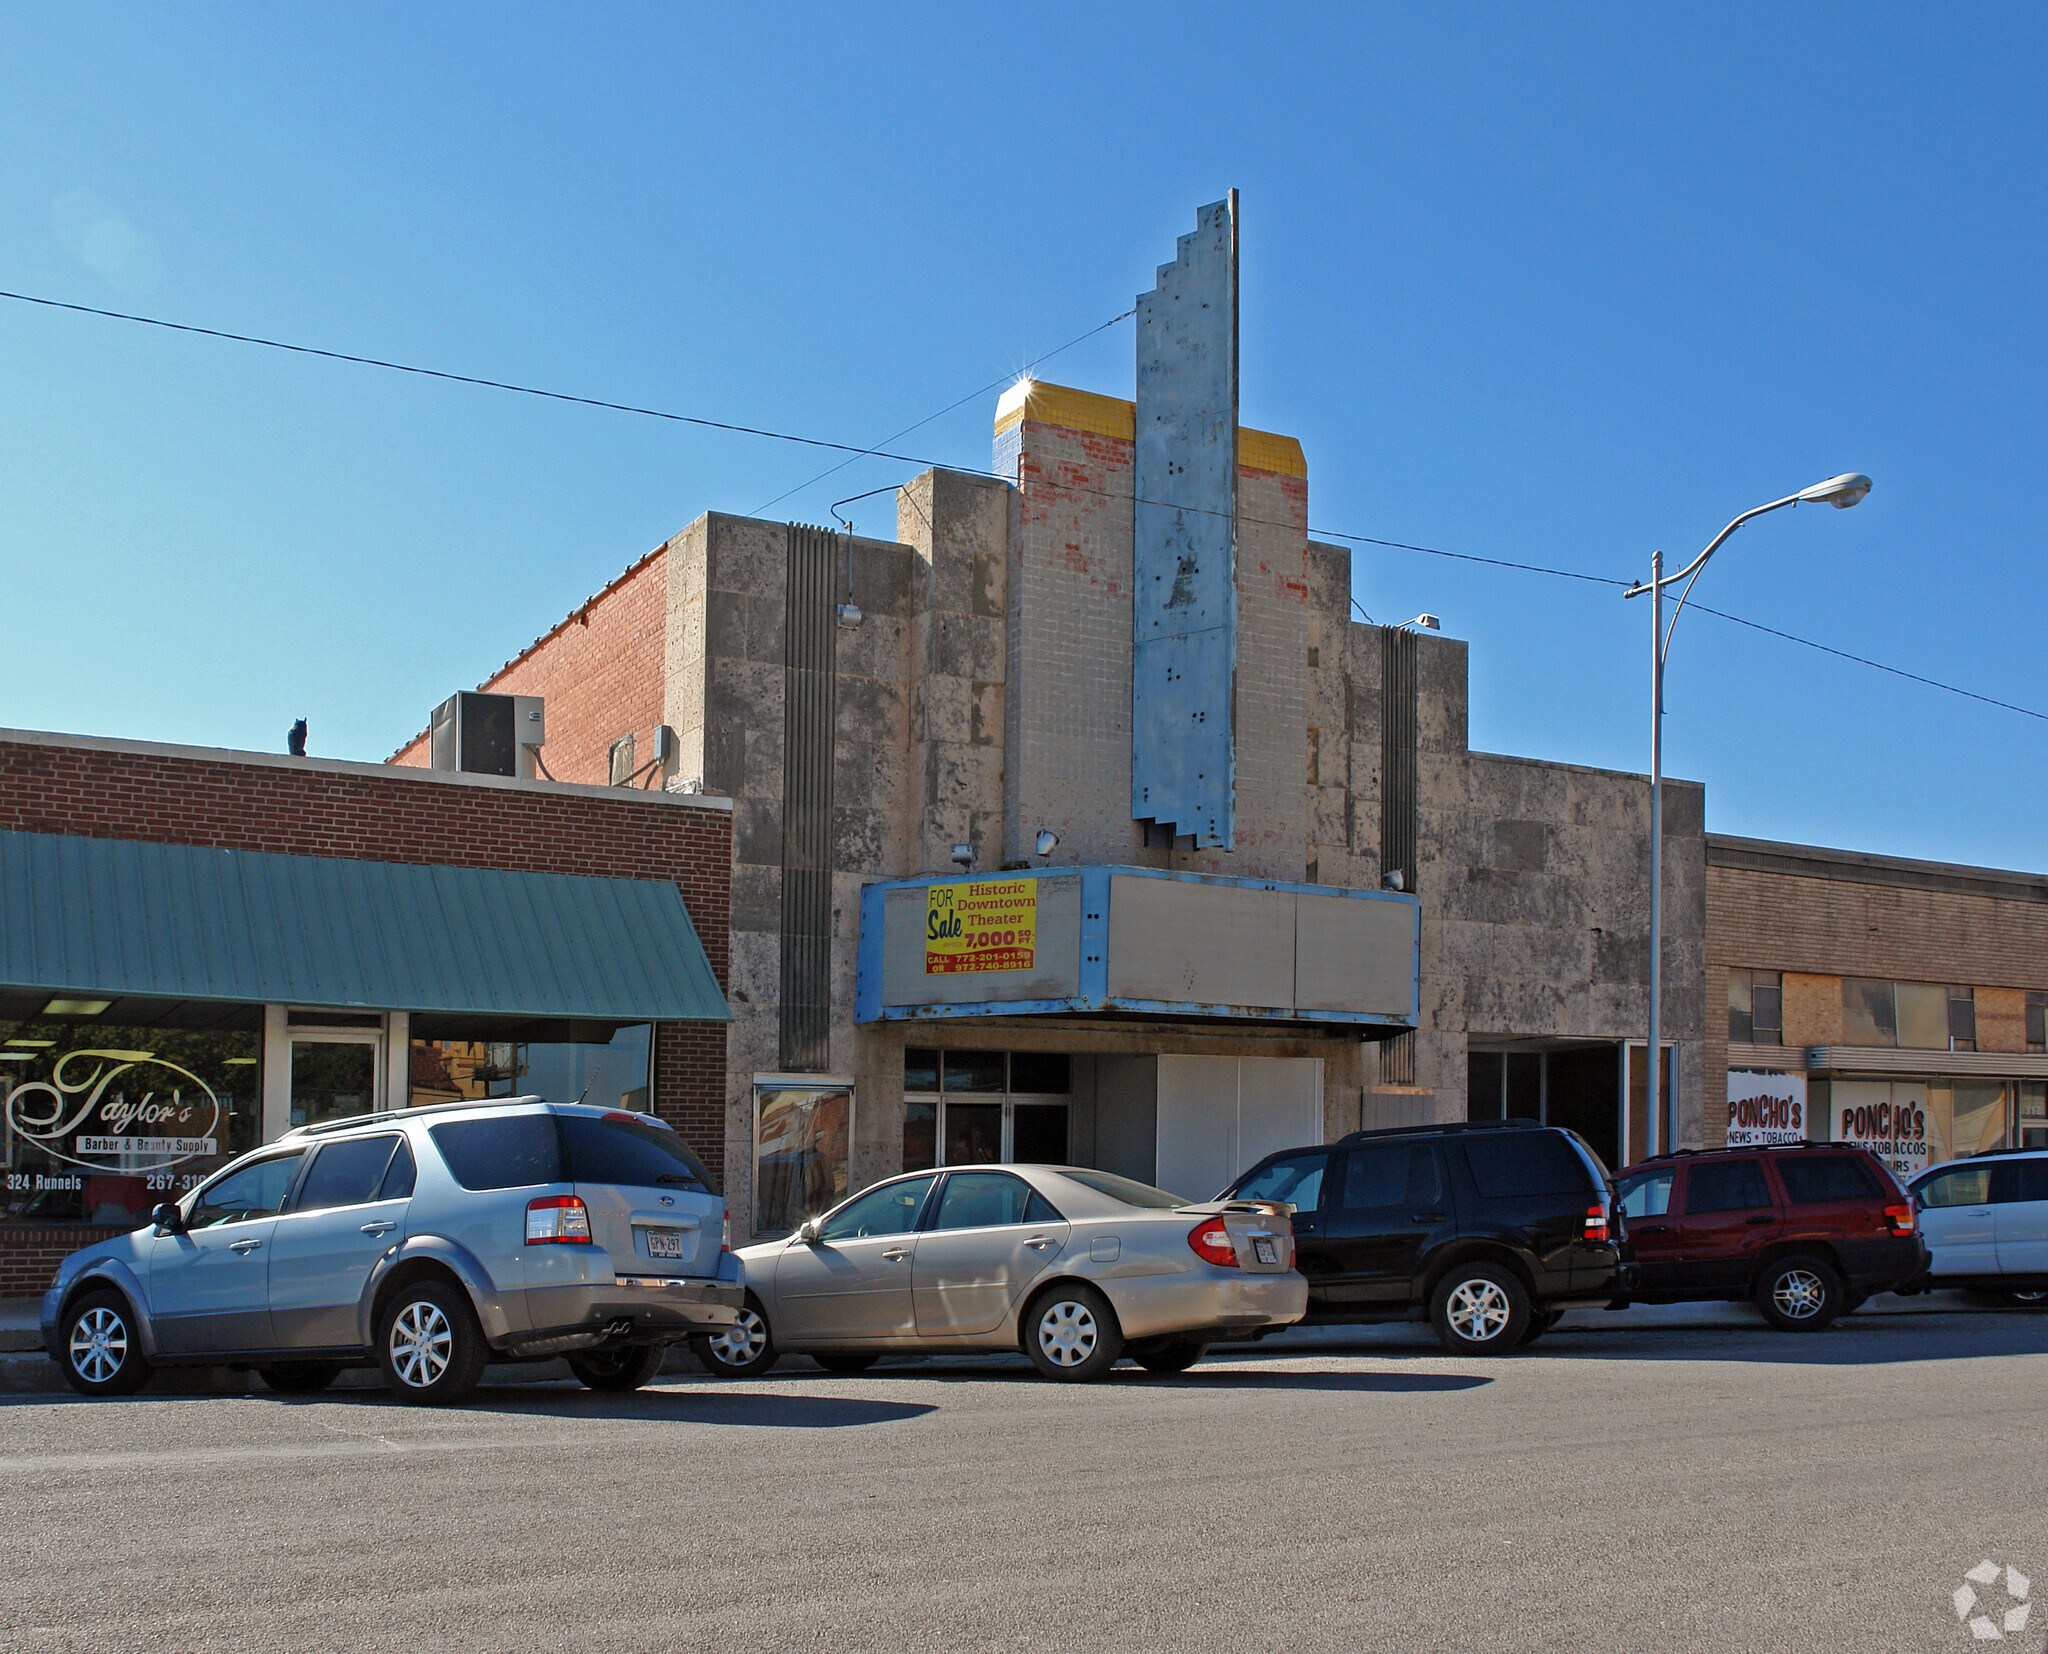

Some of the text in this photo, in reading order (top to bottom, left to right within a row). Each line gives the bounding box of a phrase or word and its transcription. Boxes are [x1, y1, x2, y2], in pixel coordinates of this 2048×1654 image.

[969, 882, 1025, 896] Historic
[930, 889, 954, 908] FOR
[958, 898, 1036, 911] Downtown
[927, 909, 963, 940] Sale
[968, 914, 1024, 926] Theater
[965, 930, 1015, 948] 7,000
[1017, 930, 1034, 938] SQ.
[928, 956, 949, 964] CALL
[955, 961, 1031, 972] 972-740-8916
[6, 1049, 192, 1139] Taylor's
[1729, 1131, 1799, 1144] NEWS TOBACCO
[85, 1138, 209, 1155] Barber & Beauty Supply
[1872, 1141, 1927, 1155] TOBACCOS
[7, 1174, 30, 1190] 324
[35, 1174, 82, 1190] Runnels
